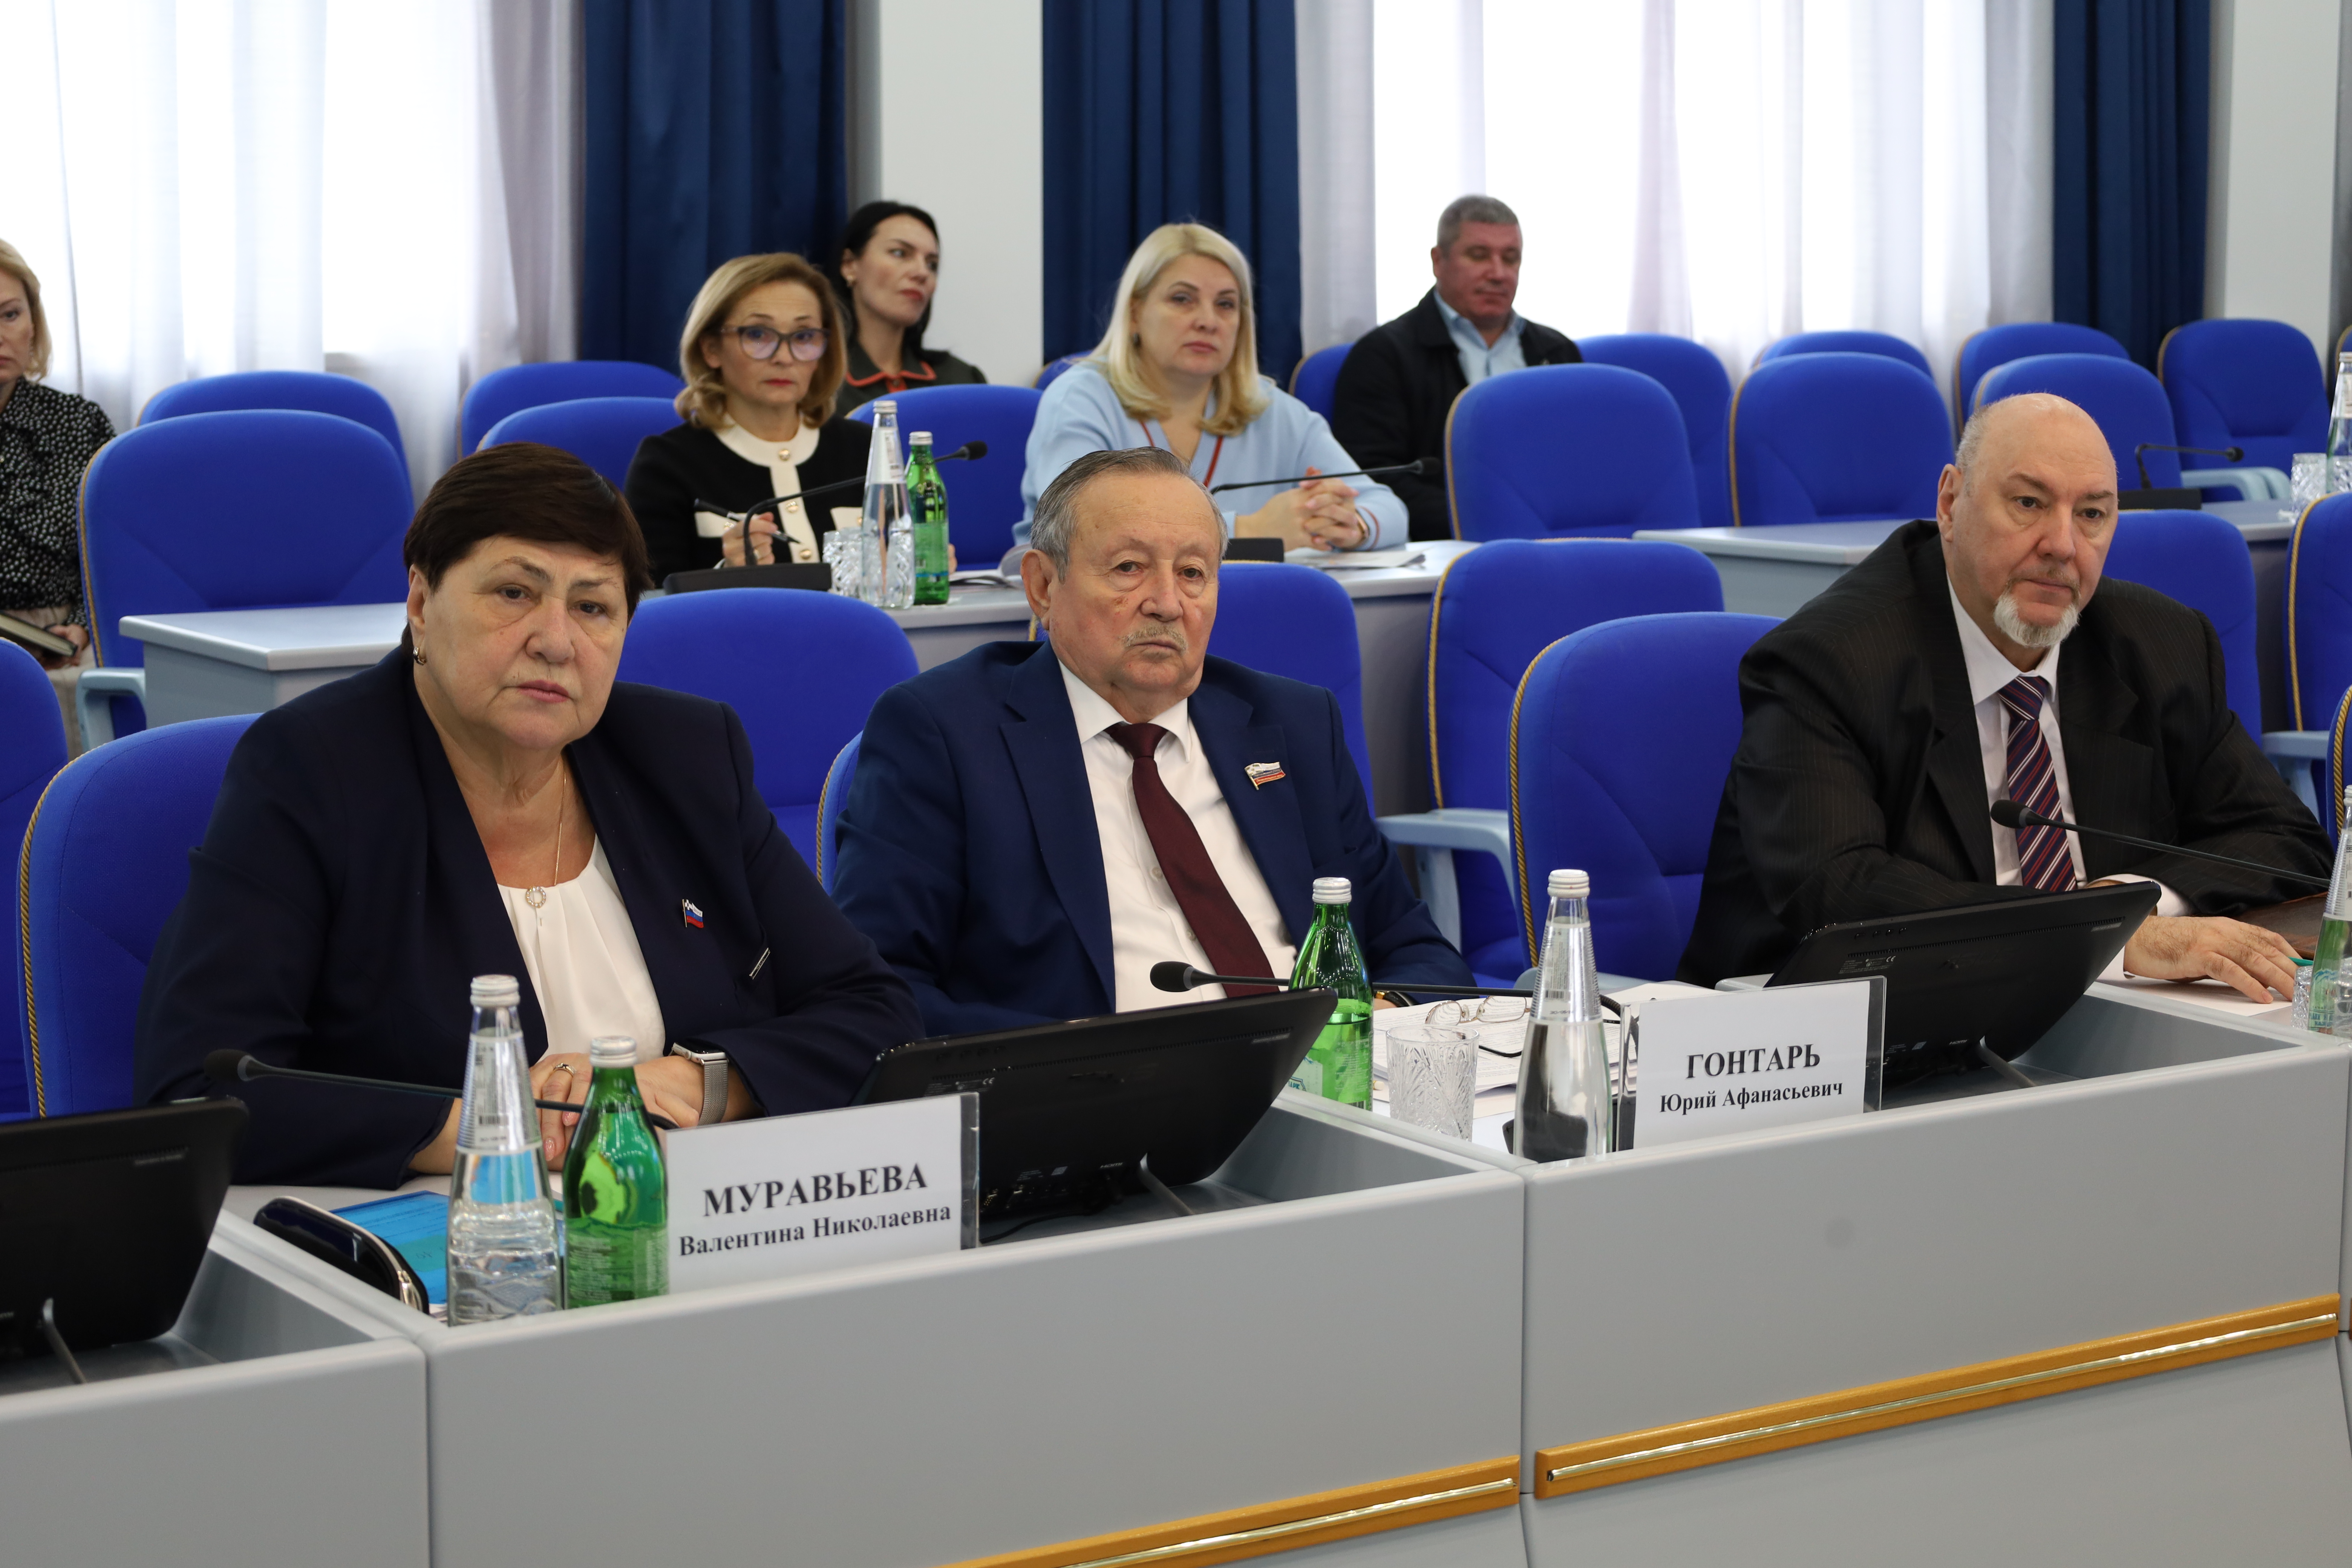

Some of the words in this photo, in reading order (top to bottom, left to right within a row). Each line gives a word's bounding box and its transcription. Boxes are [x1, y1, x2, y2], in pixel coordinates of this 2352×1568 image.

[1686, 1044, 1821, 1079] ГОНТАРЬ
[1660, 1090, 1717, 1115] Юрий
[1721, 1083, 1843, 1109] Афанасьевич
[703, 1163, 928, 1217] МУРАВЬЕВА
[679, 1226, 805, 1257] Валентина
[812, 1206, 951, 1238] Николаевна
